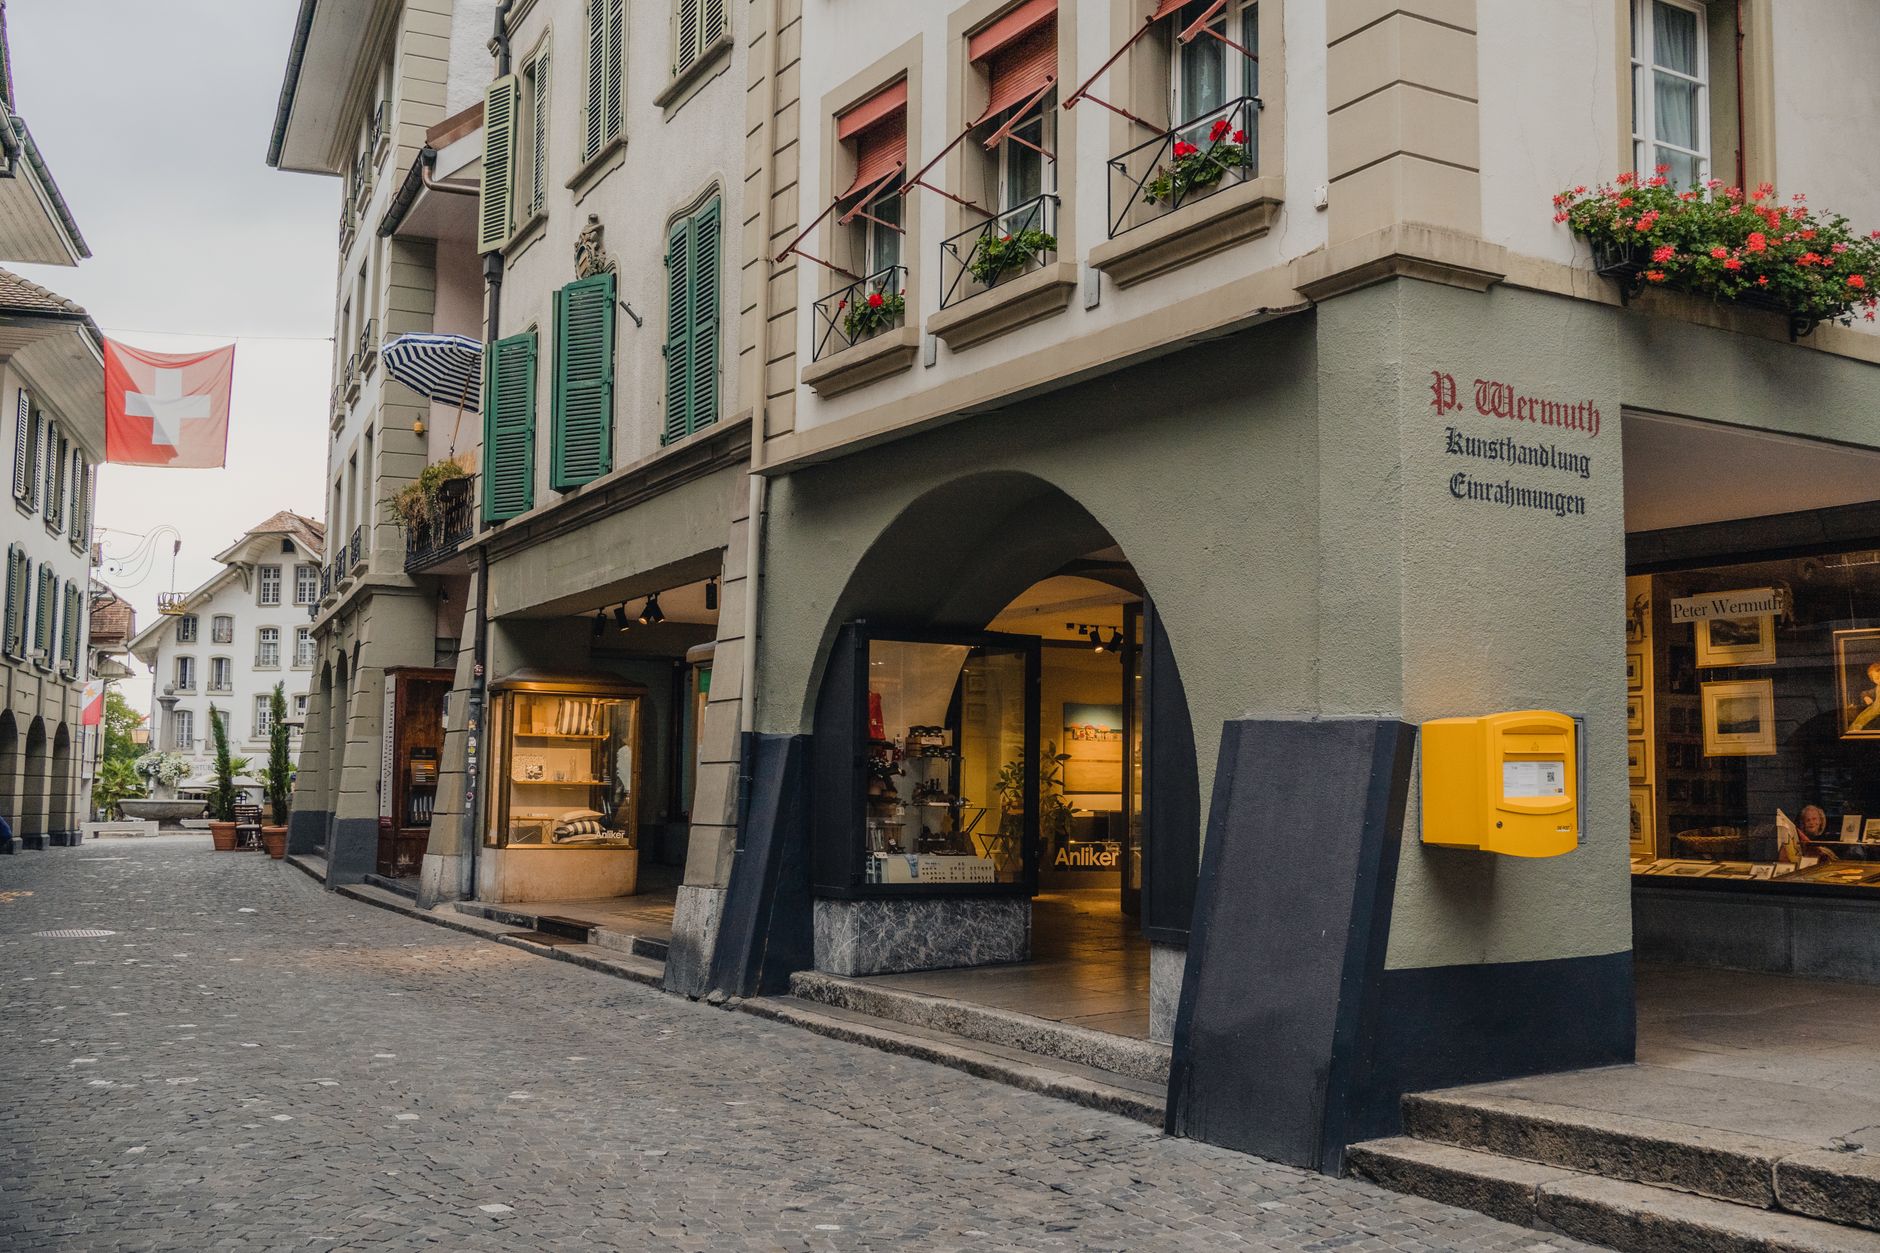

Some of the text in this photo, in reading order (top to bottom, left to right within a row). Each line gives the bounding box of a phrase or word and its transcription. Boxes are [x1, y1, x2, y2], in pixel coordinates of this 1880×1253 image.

[1430, 370, 1601, 438] P. Wermuth
[1444, 426, 1591, 479] Kunsthandlung
[1449, 472, 1586, 517] Einrahmungen
[1673, 594, 1782, 619] Peter Wermuth
[596, 829, 626, 839] Anliker
[1054, 846, 1120, 866] Anliker
